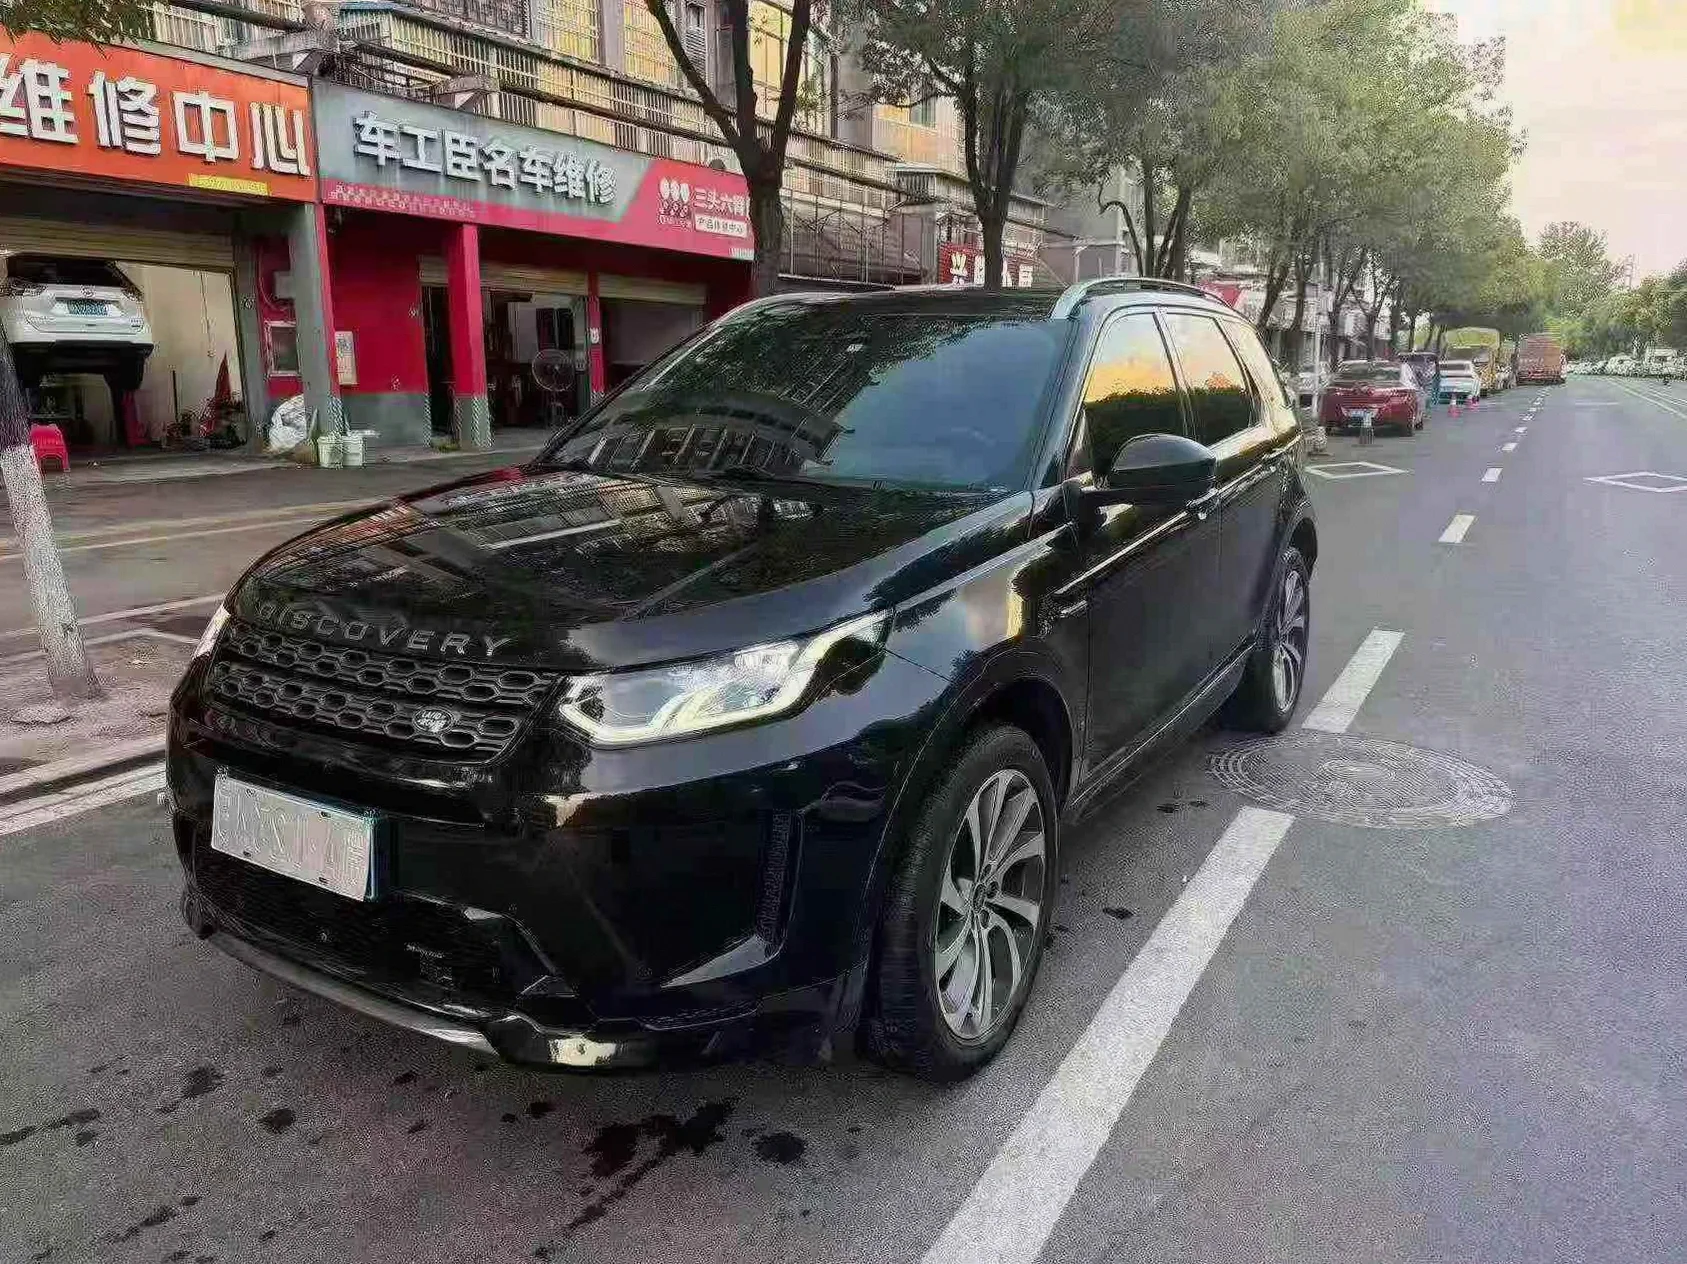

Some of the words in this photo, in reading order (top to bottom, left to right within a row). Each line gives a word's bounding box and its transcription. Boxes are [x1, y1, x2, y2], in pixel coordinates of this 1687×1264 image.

[0, 53, 311, 176] 维修中心
[353, 110, 617, 204] 车工臣名车维修
[257, 602, 514, 656] DISCOVERY
